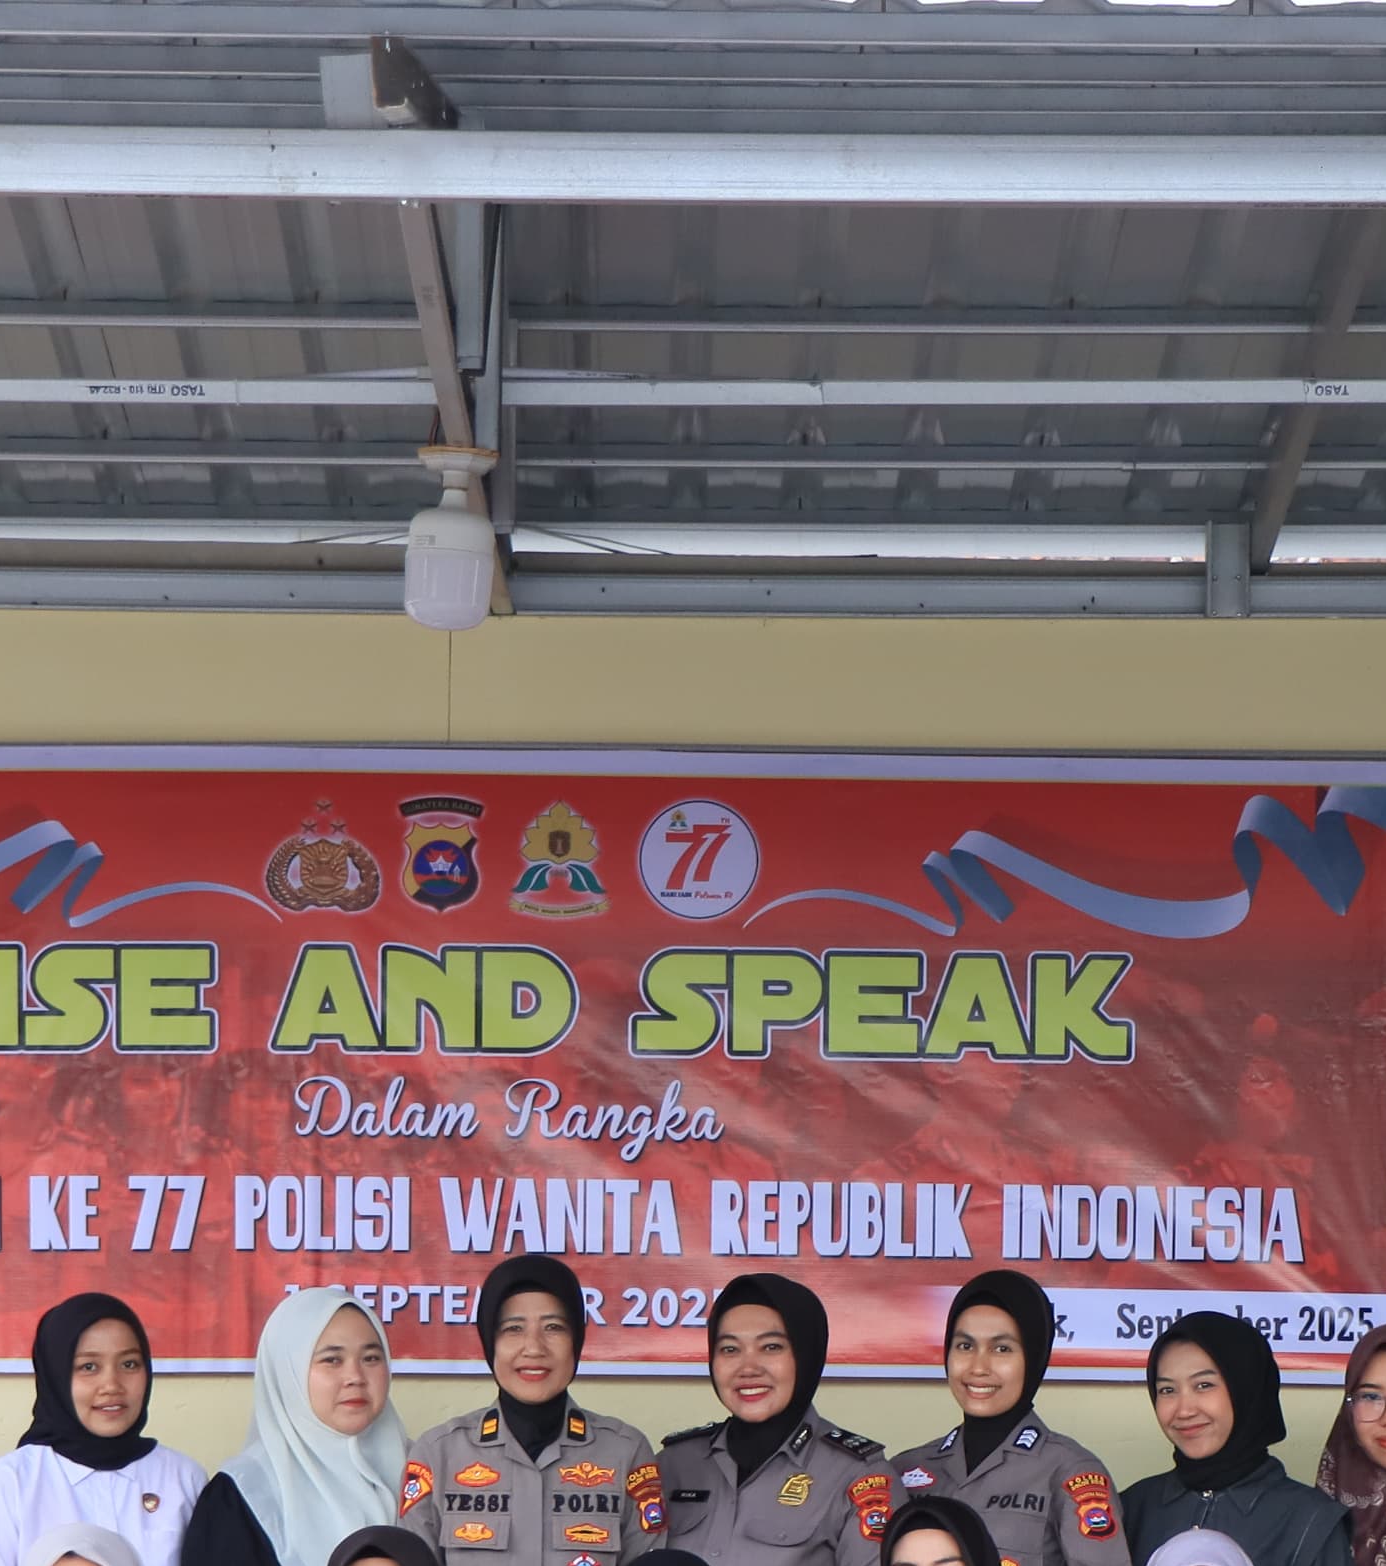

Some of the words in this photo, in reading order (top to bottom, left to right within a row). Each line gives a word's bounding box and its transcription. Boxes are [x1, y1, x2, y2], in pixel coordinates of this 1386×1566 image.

[171, 384, 205, 396] TASO
[1315, 385, 1349, 397] TASO
[665, 824, 732, 890] 77
[268, 942, 579, 1056] AND
[628, 947, 1135, 1064] SPEAK
[295, 1076, 479, 1138] Dalam
[506, 1079, 724, 1162] Rangka
[30, 1176, 98, 1250] KE
[129, 1176, 205, 1250] 77
[235, 1176, 410, 1251] POLISI
[440, 1178, 681, 1255] WANITA
[711, 1180, 971, 1258] REPUBLIK
[1003, 1185, 1303, 1262] INDONESIA
[620, 1287, 722, 1327] 202
[445, 1494, 511, 1512] YESSI
[553, 1494, 620, 1513] POLRI
[986, 1493, 1046, 1512] POLRI
